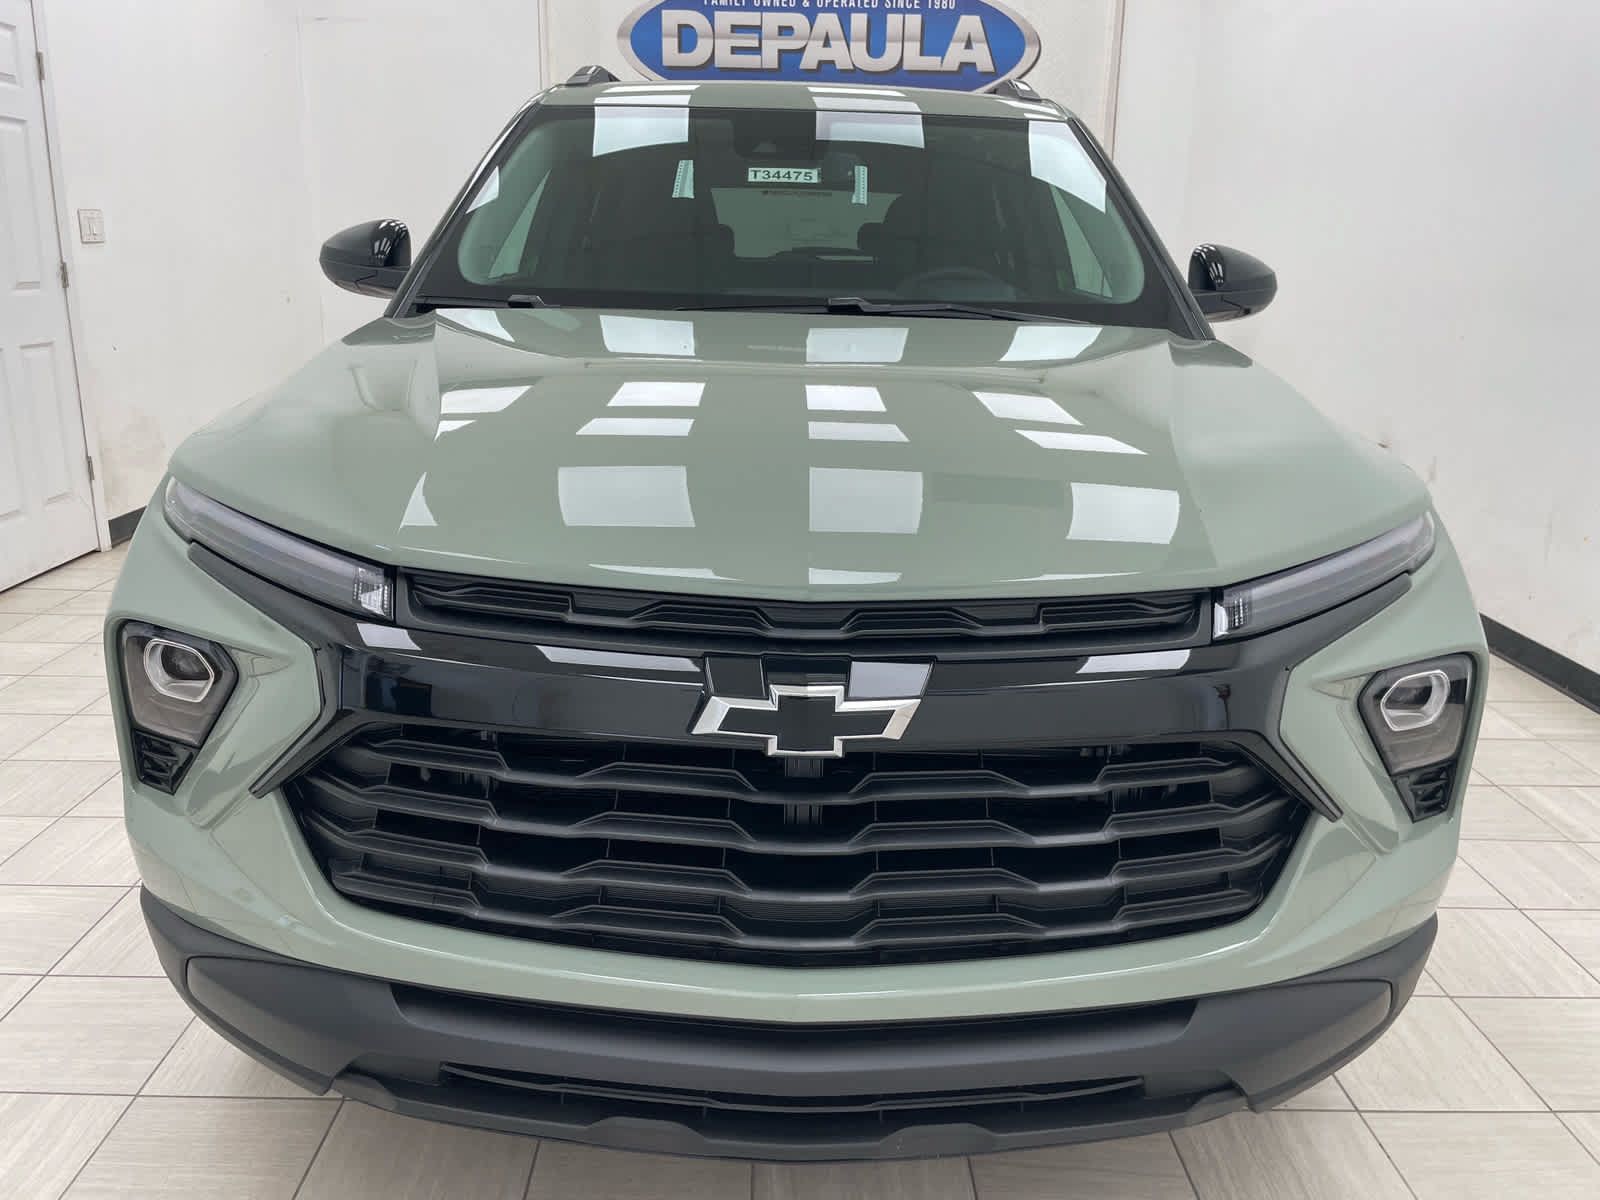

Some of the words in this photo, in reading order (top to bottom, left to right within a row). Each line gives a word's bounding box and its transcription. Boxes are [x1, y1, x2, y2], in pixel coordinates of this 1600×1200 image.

[884, 0, 921, 9] SINCE
[928, 0, 956, 9] 1980
[661, 9, 996, 73] DEPAULA
[750, 168, 813, 182] T34475
